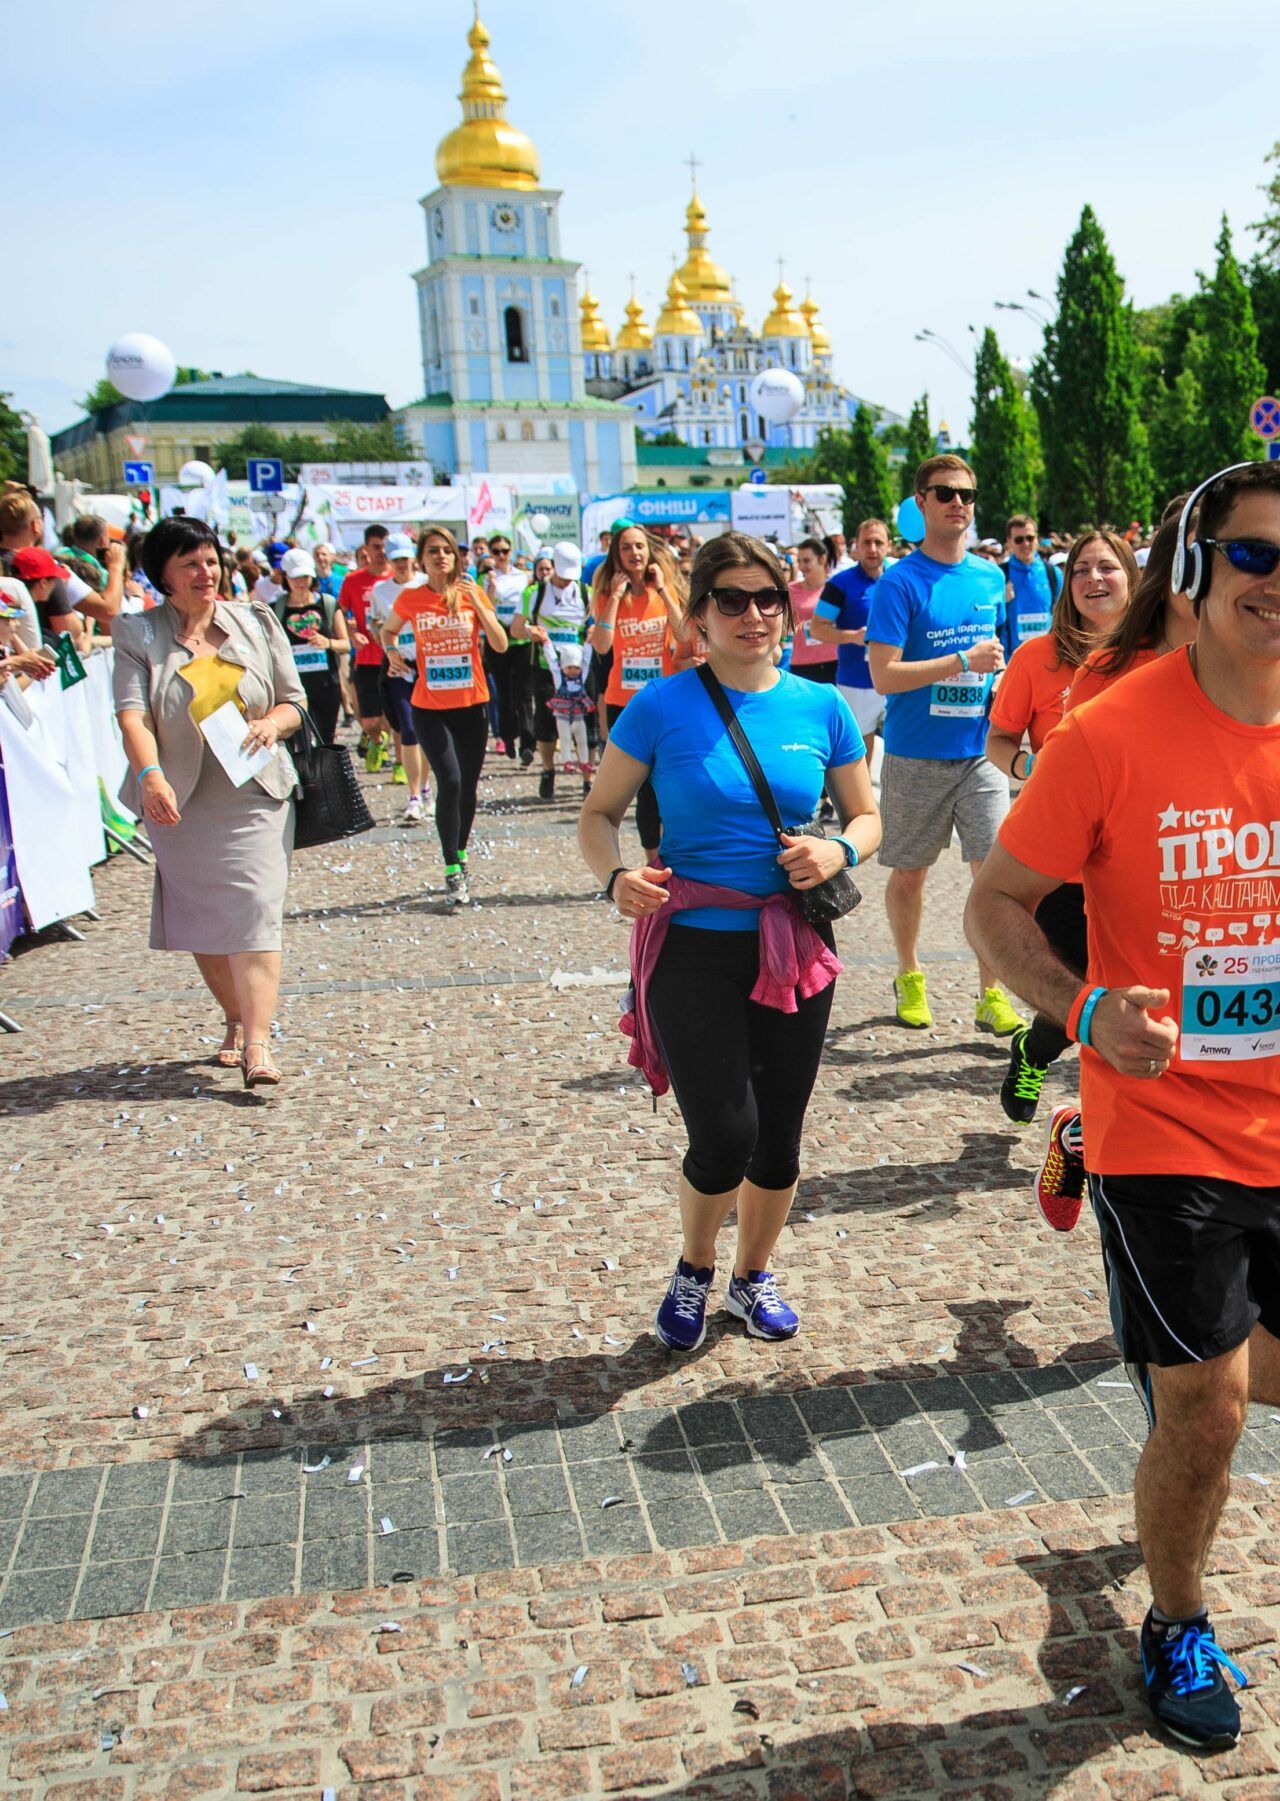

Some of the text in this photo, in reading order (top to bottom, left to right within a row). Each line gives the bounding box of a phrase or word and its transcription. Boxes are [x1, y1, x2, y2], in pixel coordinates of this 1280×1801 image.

[255, 462, 276, 490] P
[355, 497, 405, 512] СТАРТ
[525, 502, 573, 516] Amway
[638, 499, 697, 516] ФІНІШ
[430, 667, 469, 681] 04337
[937, 686, 983, 704] 03838
[1184, 807, 1233, 828] ICTV
[1160, 884, 1197, 910] ПІД
[1223, 957, 1248, 974] 25
[1200, 1044, 1232, 1055] Amway
